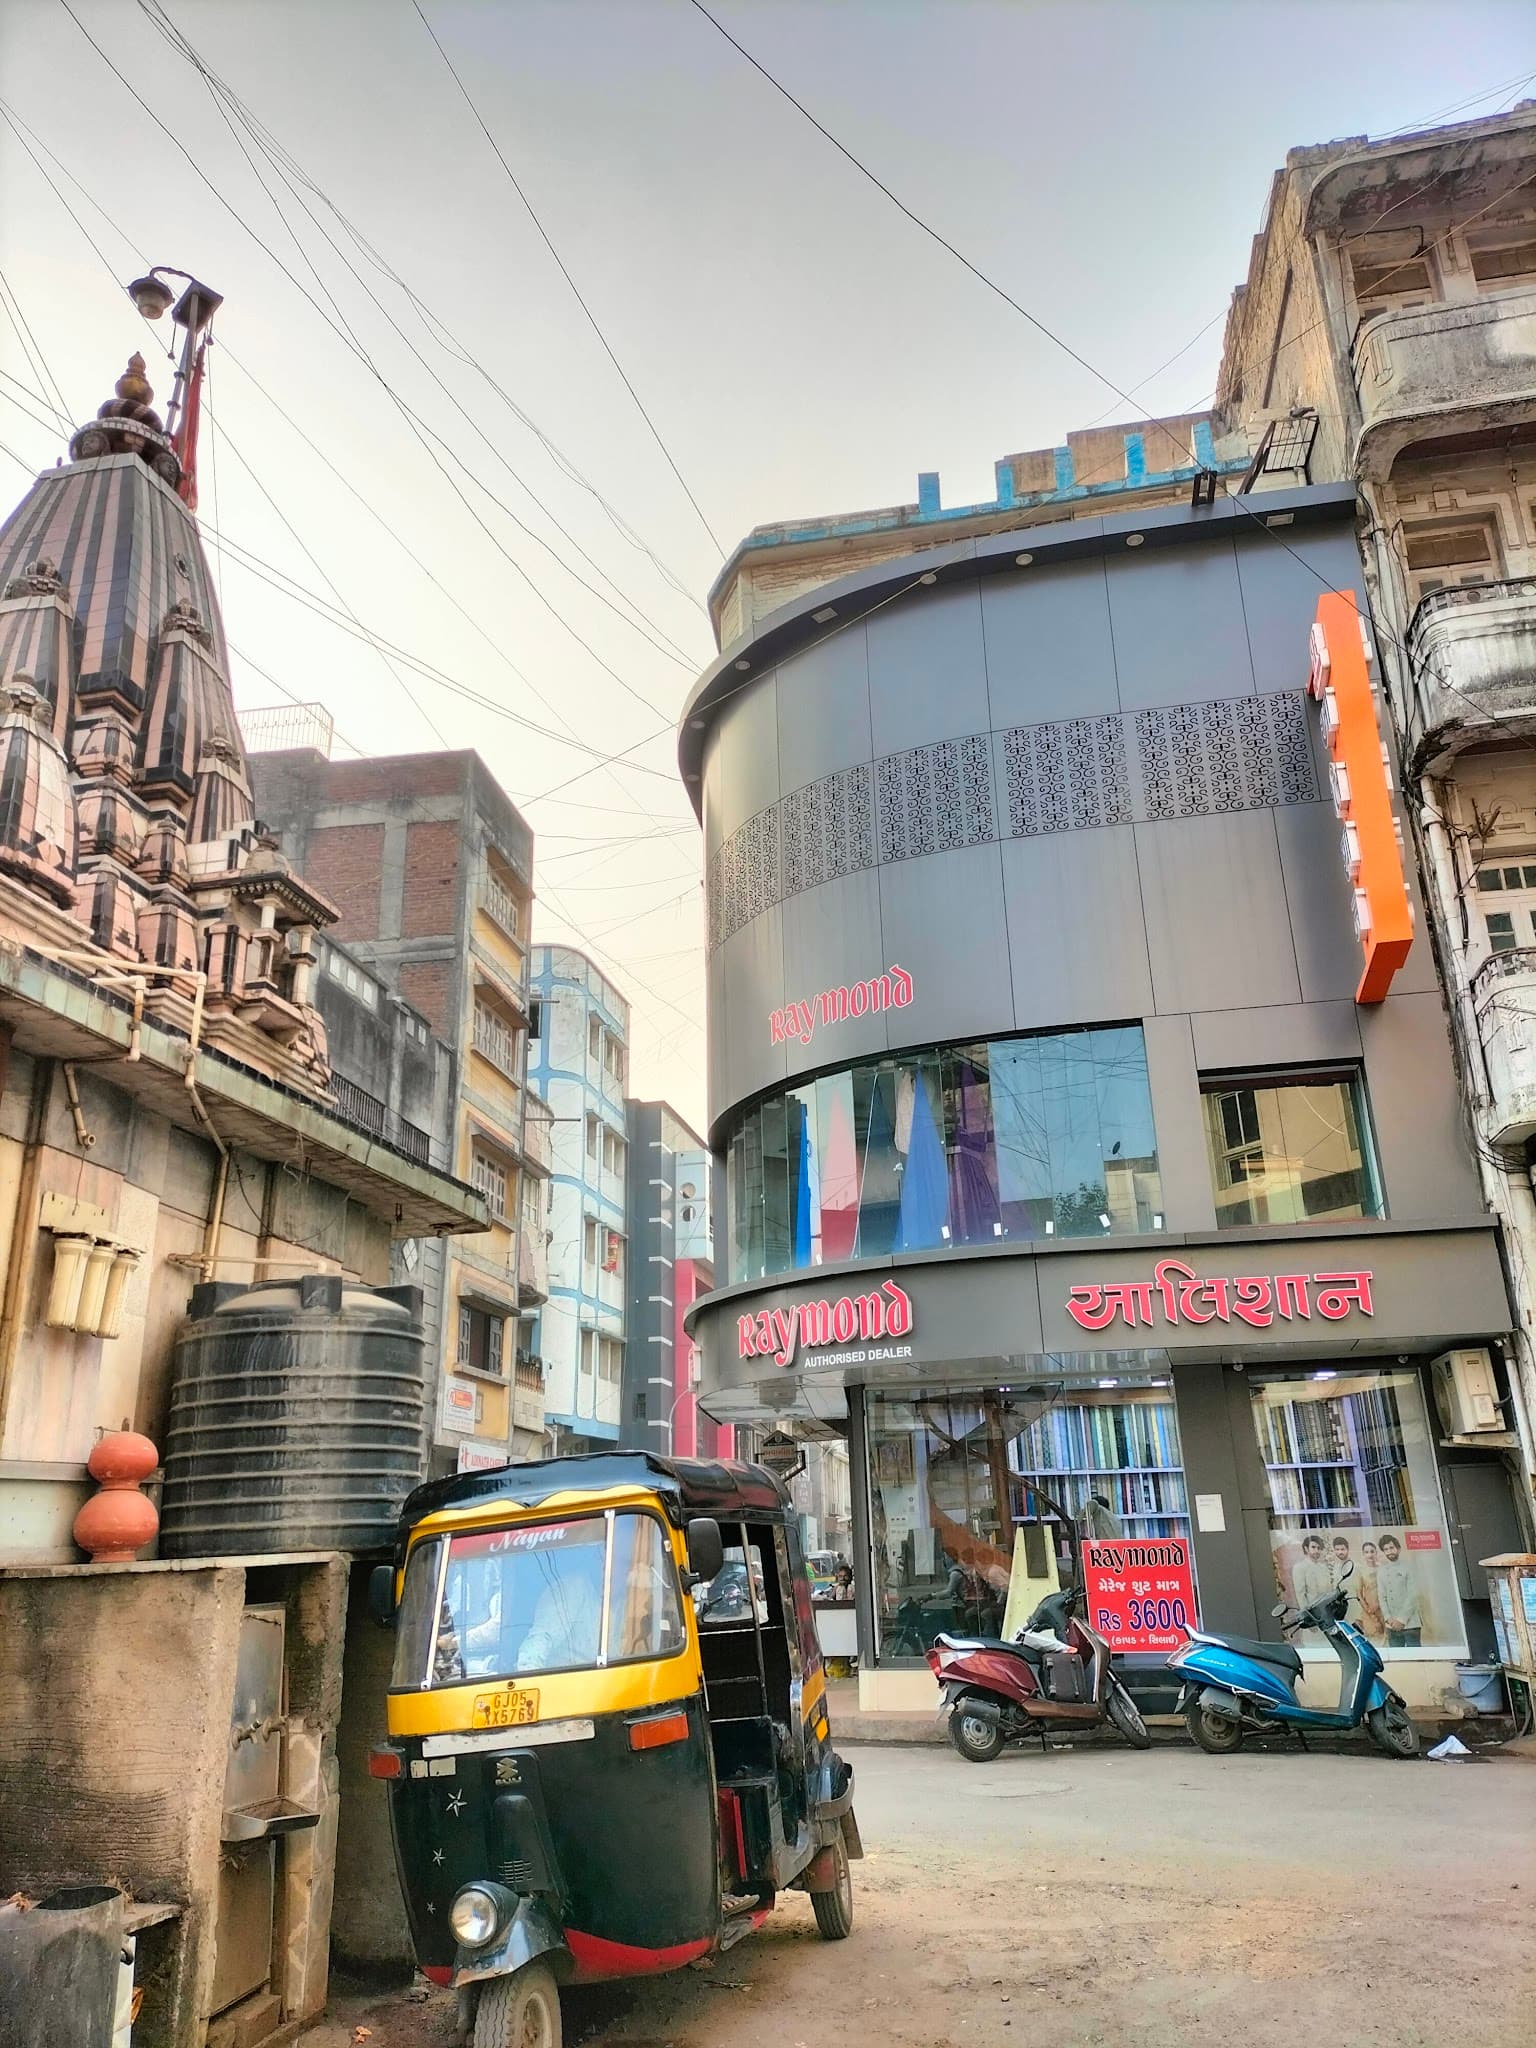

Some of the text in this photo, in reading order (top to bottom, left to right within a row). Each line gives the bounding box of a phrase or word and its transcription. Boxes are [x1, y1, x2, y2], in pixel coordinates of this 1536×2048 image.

[768, 964, 914, 1046] Raymond
[1065, 1258, 1374, 1330] આલિશાન
[737, 1279, 913, 1367] Raymond
[804, 1346, 912, 1368] AUTHORISED DEALER
[489, 1528, 567, 1552] Nayan
[1089, 1541, 1185, 1574] Raymond
[1098, 1578, 1126, 1592] મેરેજ
[1156, 1581, 1180, 1591] માત્ર
[1097, 1598, 1187, 1631] Rs 3600
[494, 1692, 527, 1709] GJ05
